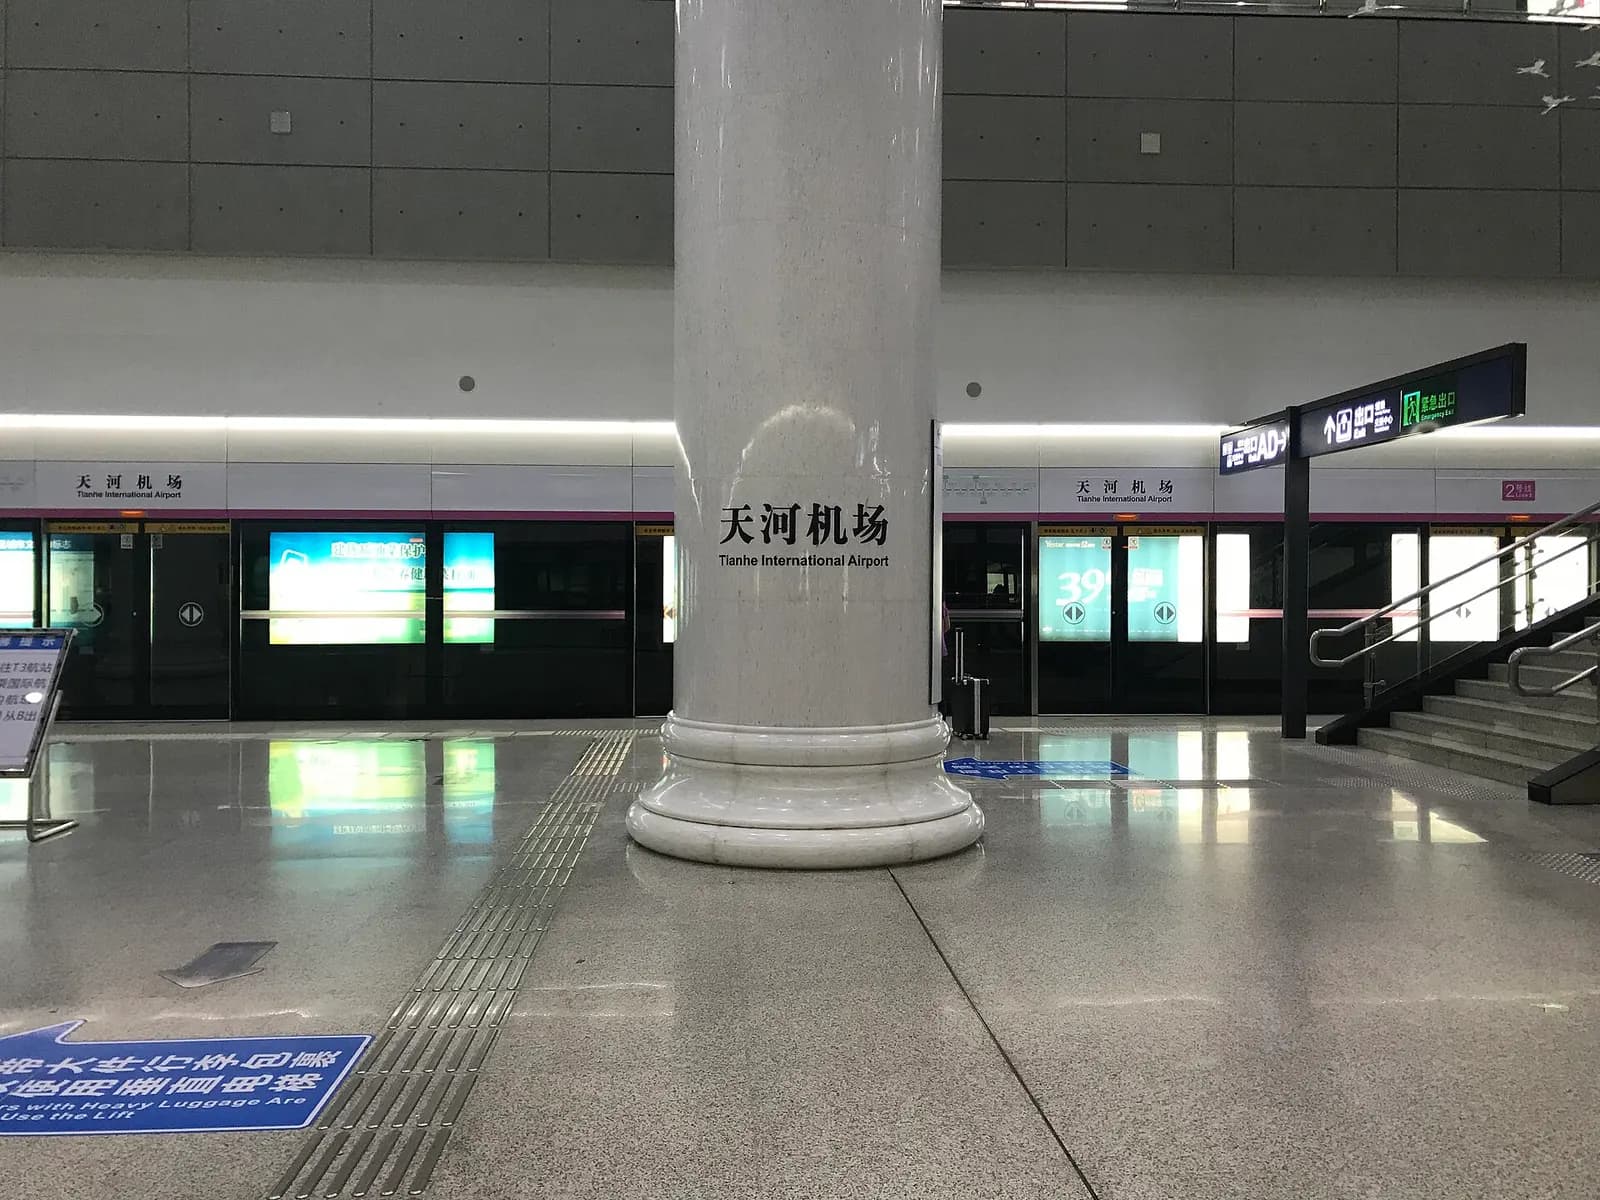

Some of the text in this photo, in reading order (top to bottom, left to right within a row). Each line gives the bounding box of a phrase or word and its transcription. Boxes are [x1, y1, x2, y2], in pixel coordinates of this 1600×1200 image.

[1421, 392, 1455, 413] 紧急出口
[1354, 404, 1374, 427] 出口
[76, 474, 182, 490] 天河机场
[1076, 479, 1174, 494] 天河机场
[105, 490, 153, 498] International
[155, 490, 181, 499] Airport
[1148, 495, 1172, 503] Airport
[719, 502, 889, 546] 天河机场
[719, 555, 889, 568] Tianhe International Airport
[0, 710, 37, 721] 从B出
[27, 1102, 76, 1111] with
[80, 1099, 154, 1110] Heavy
[158, 1097, 261, 1109] Luggage
[265, 1096, 306, 1105] Are
[0, 1111, 136, 1121] Use the Lift
